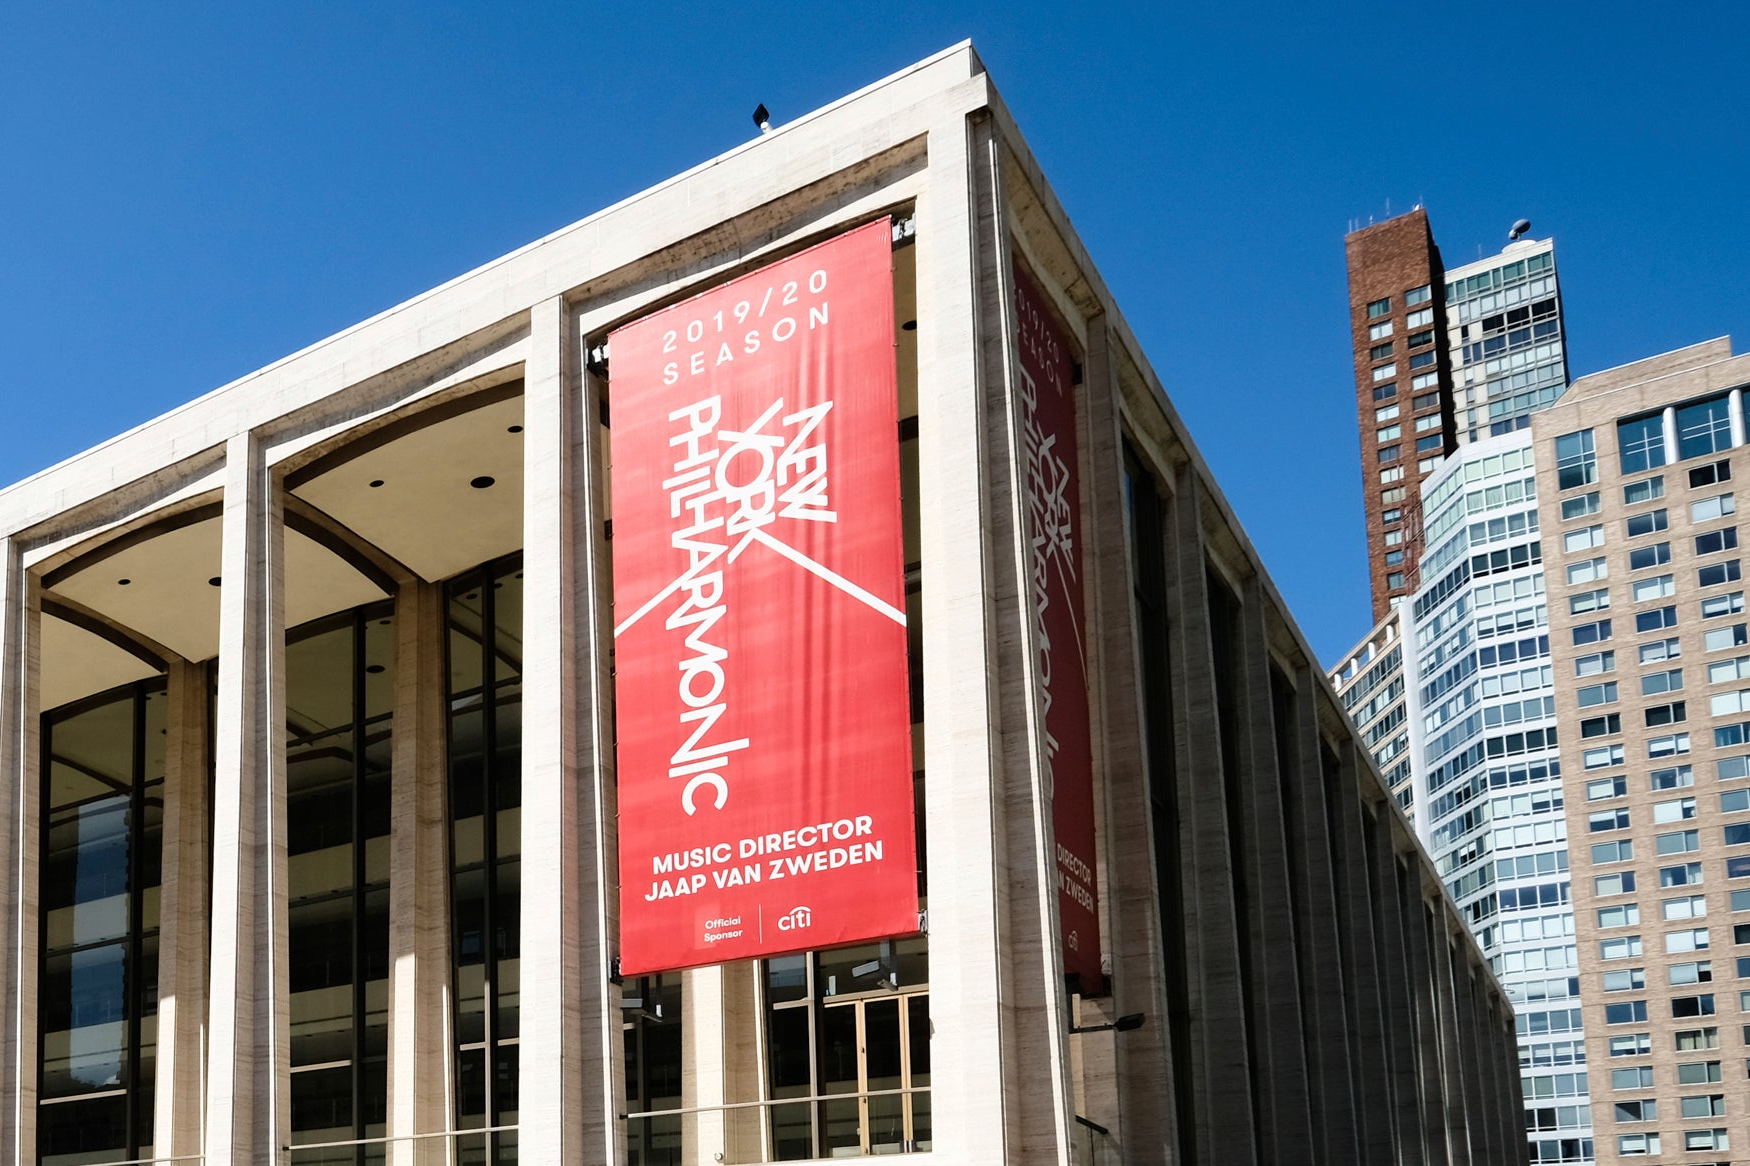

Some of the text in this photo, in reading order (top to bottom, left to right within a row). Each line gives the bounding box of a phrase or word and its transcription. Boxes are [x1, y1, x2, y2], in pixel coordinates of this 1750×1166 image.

[663, 270, 827, 353] 2019/20
[1017, 288, 1059, 364] 019/20
[663, 302, 828, 385] SEASON
[1017, 322, 1062, 398] EASON
[775, 401, 838, 522] NEW
[615, 394, 750, 817] PHILHARMONIC
[644, 840, 883, 902] JAAP VAN ZWEDEN
[653, 815, 872, 875] MUSIC DIRECTOR
[1056, 843, 1092, 887] DIRECTOR
[705, 916, 741, 930] Official
[777, 906, 811, 931] citi
[1065, 876, 1094, 915] ZWEDEN
[704, 929, 743, 943] Sponsor
